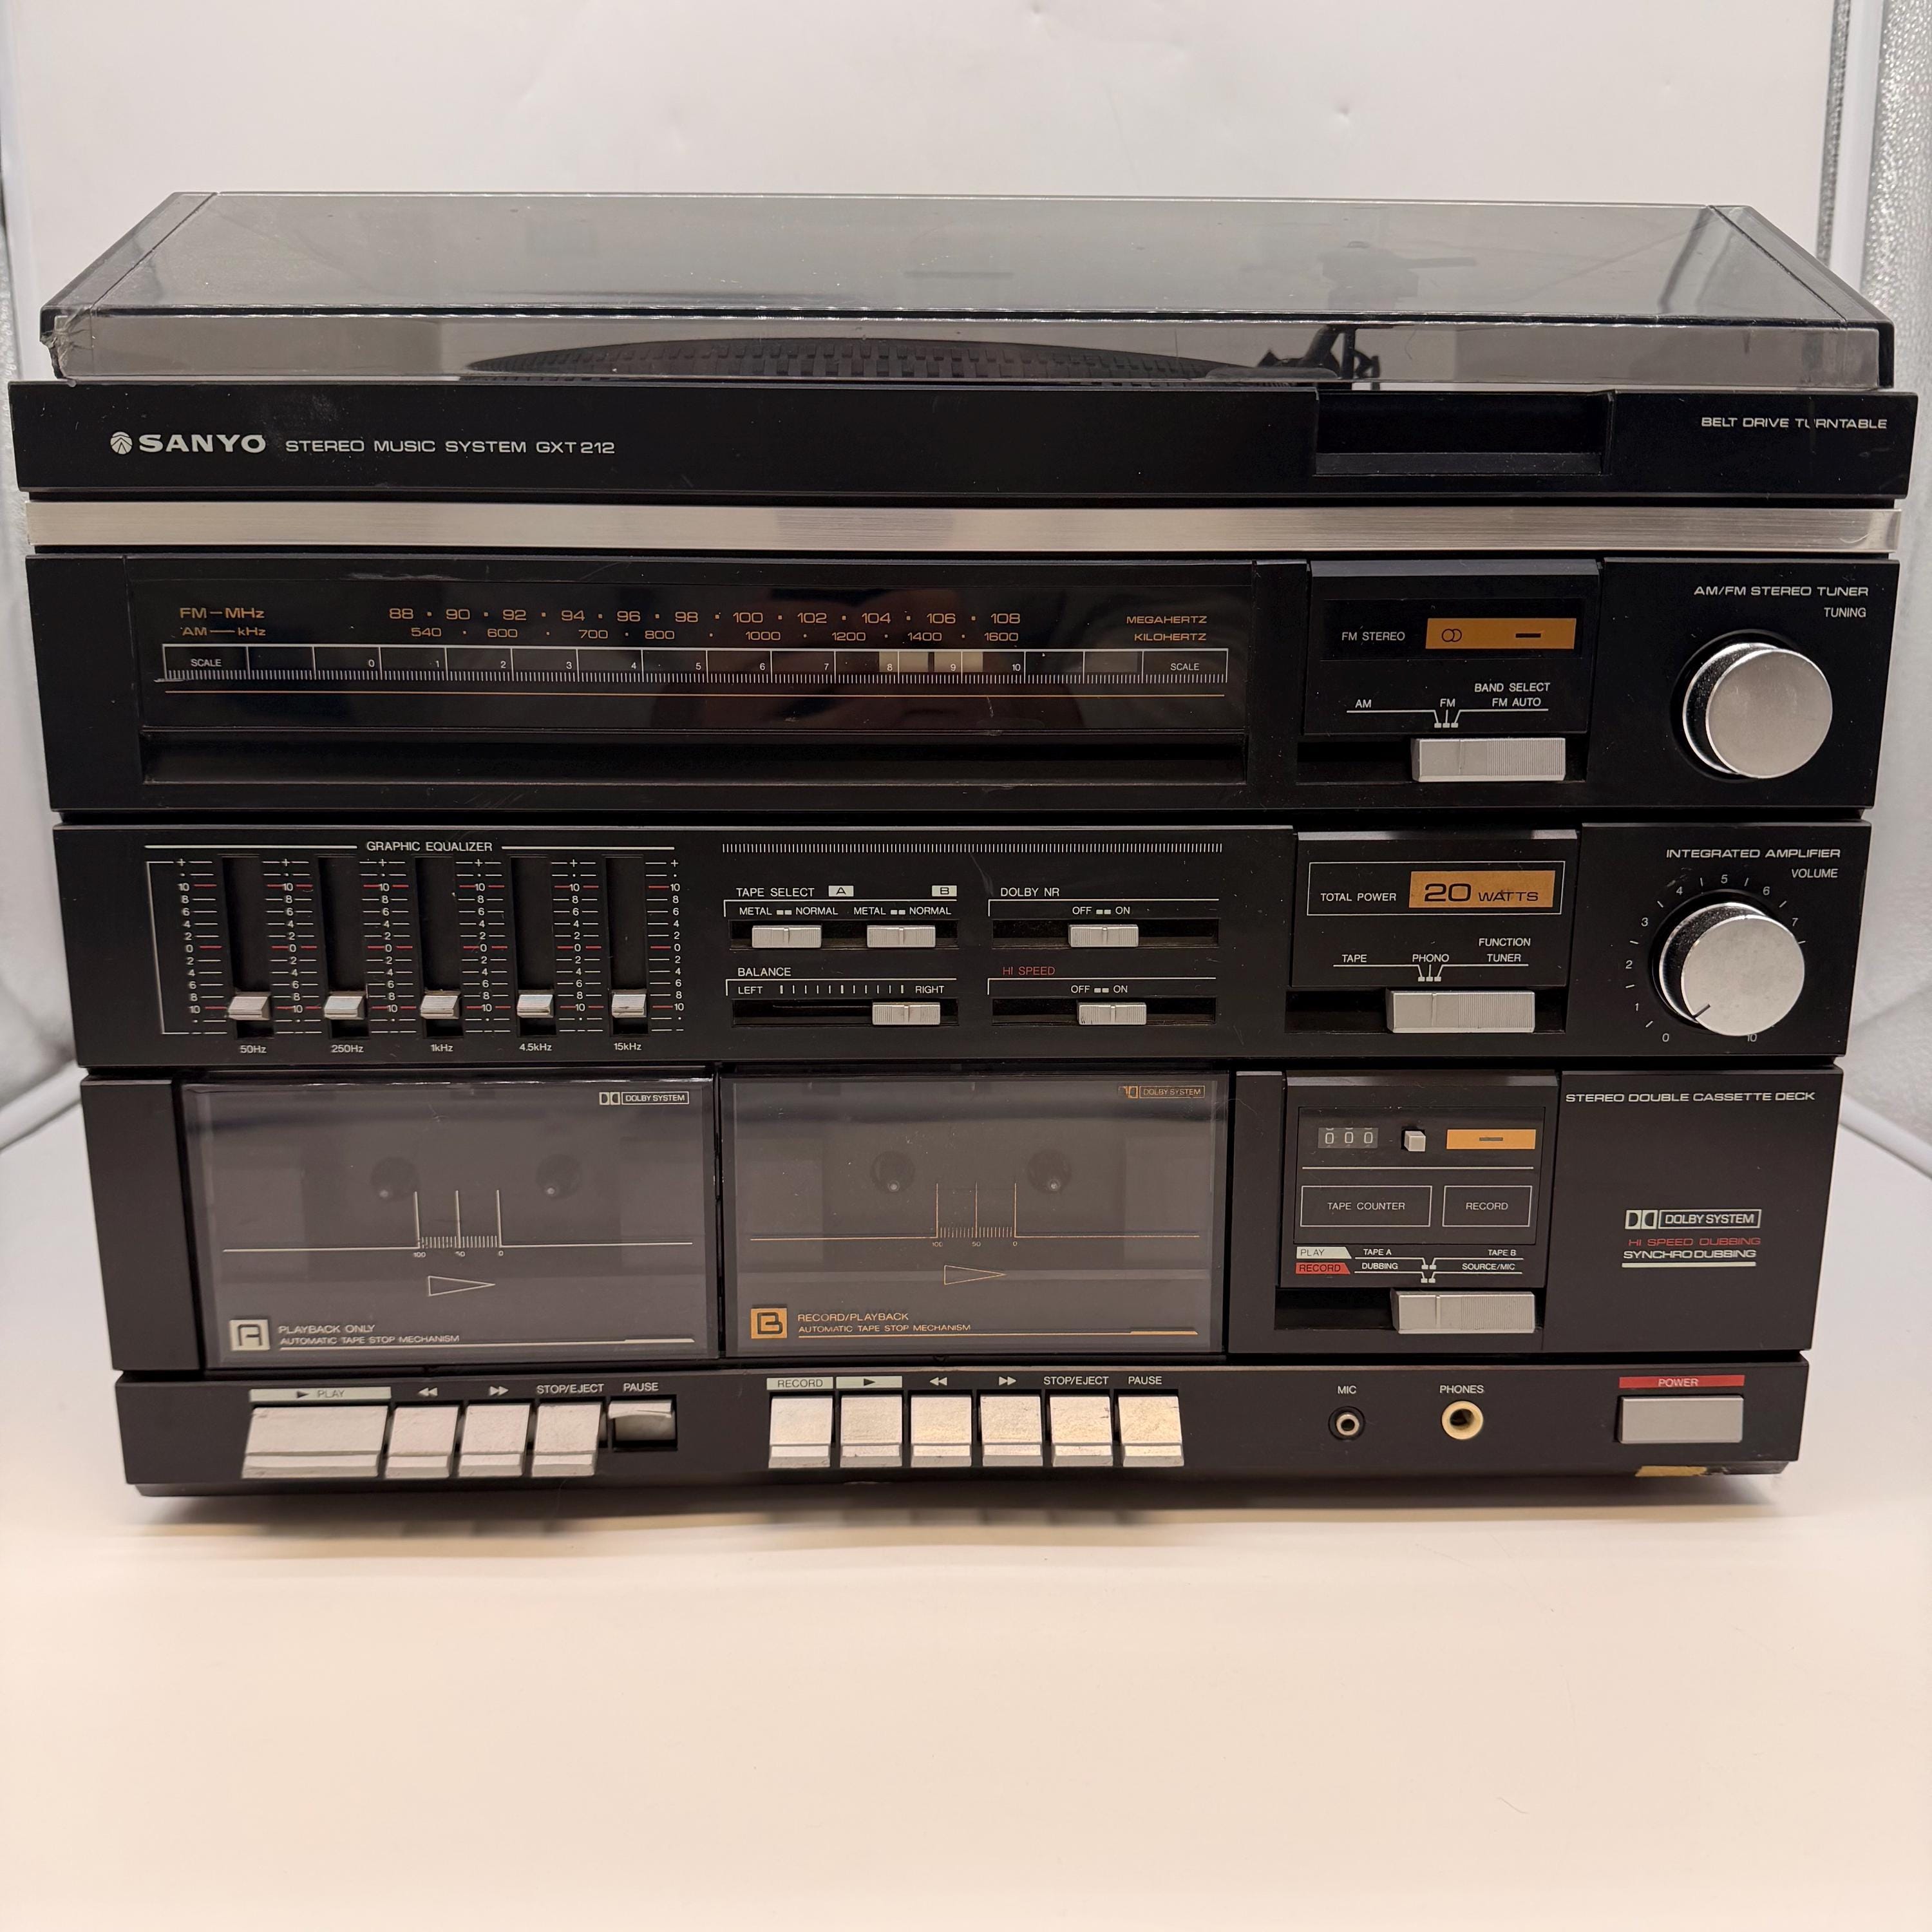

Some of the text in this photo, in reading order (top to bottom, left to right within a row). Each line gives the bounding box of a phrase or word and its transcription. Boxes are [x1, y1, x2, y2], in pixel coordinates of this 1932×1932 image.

[1701, 417, 1888, 429] BELT DRIVE TURNTABLE
[138, 434, 266, 453] SANYO
[285, 440, 365, 452] STEREO
[374, 440, 436, 452] MUSIC
[445, 440, 526, 453] SYSTEM
[1694, 586, 1869, 596] AM/FM STEREO TUNER
[389, 608, 1021, 624] 88 90 92 94 96 98 100 102 104 106 108
[1824, 607, 1866, 618] TUNING
[1126, 616, 1208, 624] MEGAHERTZ
[411, 627, 1019, 641] 540 600 700 800 1000 1200 1400 1600
[1134, 632, 1207, 641] KILOHERTZ
[1341, 631, 1405, 641] FM STEREO
[190, 658, 222, 667] SCALE
[1170, 663, 1200, 671] SCALE
[1474, 682, 1551, 692] BAND SELECT
[1355, 699, 1372, 708] AM
[1439, 698, 1455, 708] FM
[1492, 697, 1542, 707] FM AUTO
[366, 841, 493, 851] GRAPHIC EQUALIZER
[1666, 849, 1841, 858] INTEGRATED AMPLIFIER
[1791, 868, 1839, 878] VOLUME
[1720, 874, 1728, 884] 5
[670, 883, 681, 892] 10
[735, 887, 815, 897] TAPE SELECT
[835, 887, 846, 895] A
[940, 887, 950, 895] B
[1000, 887, 1060, 897] DOLBY NR
[1676, 886, 1683, 895] 4
[1763, 886, 1770, 896] 6
[1424, 883, 1539, 902] 20 WATTS
[672, 895, 679, 904] 8
[1320, 893, 1397, 902] TOTAL POWER
[672, 907, 679, 916] 6
[739, 907, 773, 915] METAL
[795, 906, 838, 915] NORMAL
[853, 907, 886, 915] METAL
[909, 906, 952, 915] NORMAL
[1072, 906, 1092, 915] OFF
[1115, 906, 1130, 915] ON
[673, 920, 679, 928] 4
[1641, 917, 1649, 927] 3
[1792, 917, 1799, 927] 7
[674, 931, 680, 940] 2
[1479, 937, 1531, 947] FUNCTION
[674, 943, 681, 952] 0
[674, 955, 681, 964] 2
[1341, 954, 1367, 963] TAPE
[1412, 953, 1450, 963] PHONO
[1486, 953, 1521, 962] TUNER
[1625, 960, 1633, 969] 2
[737, 967, 791, 977] BALANCE
[1003, 966, 1056, 976] HI SPEED
[675, 979, 682, 987] 6
[738, 986, 763, 994] LEFT
[915, 985, 945, 994] RIGHT
[1070, 985, 1090, 994] OFF
[1113, 985, 1128, 994] ON
[676, 990, 683, 999] 8
[675, 1003, 685, 1012] 10
[1662, 1033, 1670, 1042] 0
[1746, 1033, 1757, 1042] 10
[240, 1045, 267, 1054] 50Hz
[331, 1044, 365, 1053] 250Hz
[430, 1043, 453, 1052] 1kHz
[519, 1043, 553, 1052] 4.5kHz
[614, 1042, 642, 1051] 15kHz
[1566, 1092, 1815, 1103] STEREO DOUBLE CASSETTE DECK
[1327, 1202, 1405, 1211] TAPE COUNTER
[1466, 1202, 1508, 1211] RECORD
[1665, 1213, 1755, 1224] DOLBY SYSTEM
[1647, 1238, 1694, 1247] SPEED
[1699, 1237, 1761, 1246] DUBBING
[1300, 1248, 1325, 1256] PLAY
[1299, 1264, 1341, 1273] RECORD
[1462, 1262, 1515, 1271] SOURCE/MIC
[797, 1312, 909, 1322] RECORD/PLAYBACK
[278, 1325, 375, 1334] PLAYBACK ONLY
[798, 1325, 853, 1333] AUTOMATIC
[279, 1337, 337, 1345] AUTOMATIC
[369, 1336, 395, 1344] STOP
[399, 1335, 460, 1343] MECHANISM
[777, 1378, 824, 1388] RECORD
[1043, 1376, 1110, 1385] STOP/EJECT
[1128, 1376, 1162, 1385] PAUSE
[1658, 1378, 1700, 1388] POWER
[536, 1383, 605, 1394] STOP/EJECT
[623, 1382, 659, 1392] PAUSE
[1338, 1385, 1357, 1394] MIC
[1439, 1385, 1484, 1394] PHONES
[317, 1389, 346, 1399] PLAY
